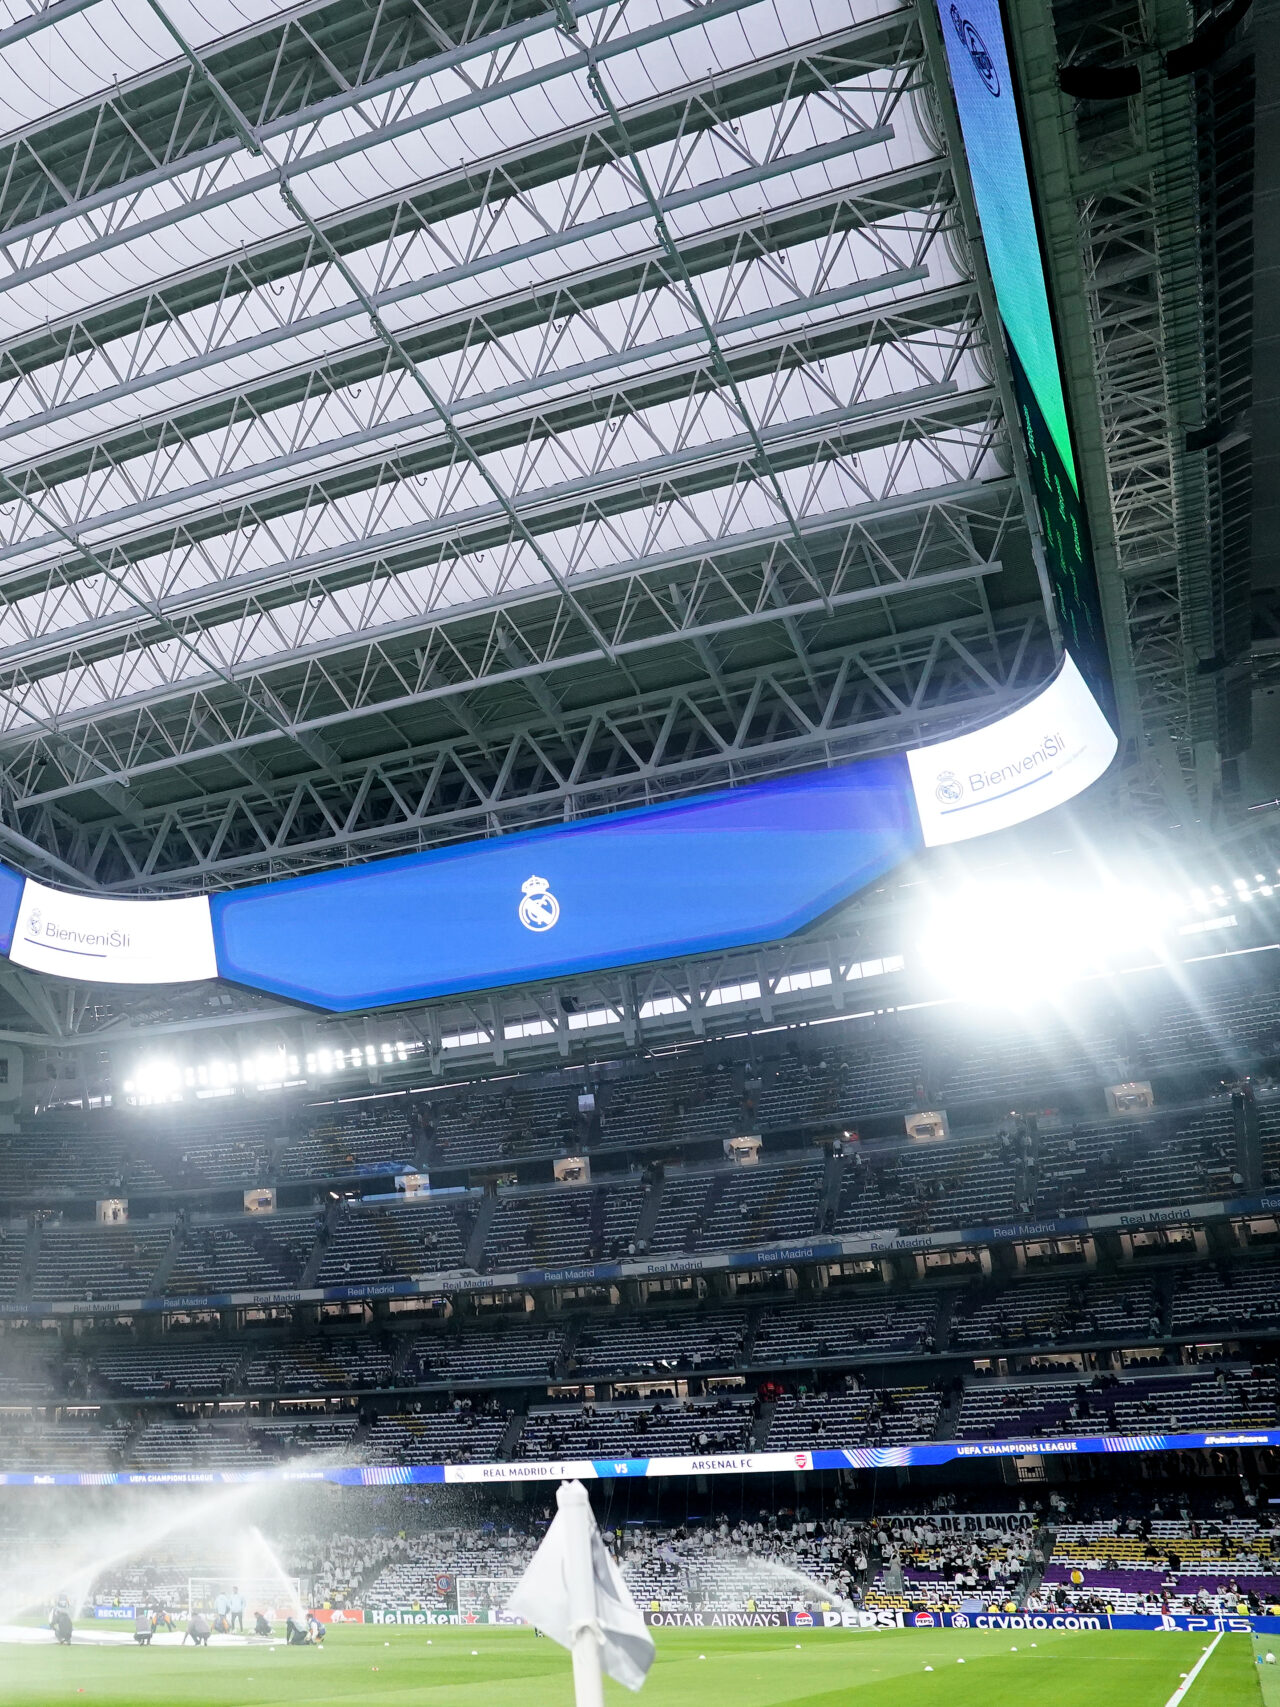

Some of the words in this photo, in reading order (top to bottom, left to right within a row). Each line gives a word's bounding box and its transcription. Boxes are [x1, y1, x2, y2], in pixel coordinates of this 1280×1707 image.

[968, 732, 1066, 792] BienveniŠli
[46, 922, 130, 947] BienveniŠli
[1261, 1199, 1280, 1208] Re
[1120, 1213, 1148, 1225] Real
[1150, 1209, 1191, 1222] Madrid
[993, 1227, 1017, 1238] Real
[1019, 1223, 1056, 1235] Madrid
[896, 1237, 932, 1248] Madrid
[758, 1252, 778, 1261] Real
[780, 1249, 813, 1259] Madrid
[647, 1264, 668, 1273] Real
[670, 1261, 703, 1271] Madrid
[544, 1272, 563, 1281] Real
[565, 1269, 595, 1279] Madrid
[347, 1288, 364, 1296] Real
[367, 1285, 394, 1294] Madrid
[443, 1282, 461, 1290] Real
[464, 1279, 493, 1288] Madrid
[163, 1299, 180, 1307] Real
[182, 1298, 207, 1306] Madrid
[254, 1295, 270, 1303] Real
[273, 1293, 301, 1301] Madrid
[957, 1445, 981, 1455] UEFA
[982, 1443, 1036, 1454] CHAMPIONS
[1037, 1442, 1077, 1452] LEAGUE
[614, 1463, 628, 1473] VS
[691, 1459, 737, 1470] ARSENAL
[740, 1458, 753, 1468] FC
[483, 1469, 507, 1478] REAL
[510, 1467, 547, 1477] MADRID
[940, 1516, 961, 1532] DE
[964, 1514, 1032, 1533] BLANCO
[98, 1609, 132, 1618] RECYCLE
[372, 1610, 461, 1625] Heineken
[650, 1613, 703, 1627] QATAR
[712, 1613, 781, 1627] AIRWAYS
[822, 1612, 905, 1628] PEPSI
[976, 1613, 1100, 1630] crypto.com
[1186, 1618, 1252, 1633] PS5
